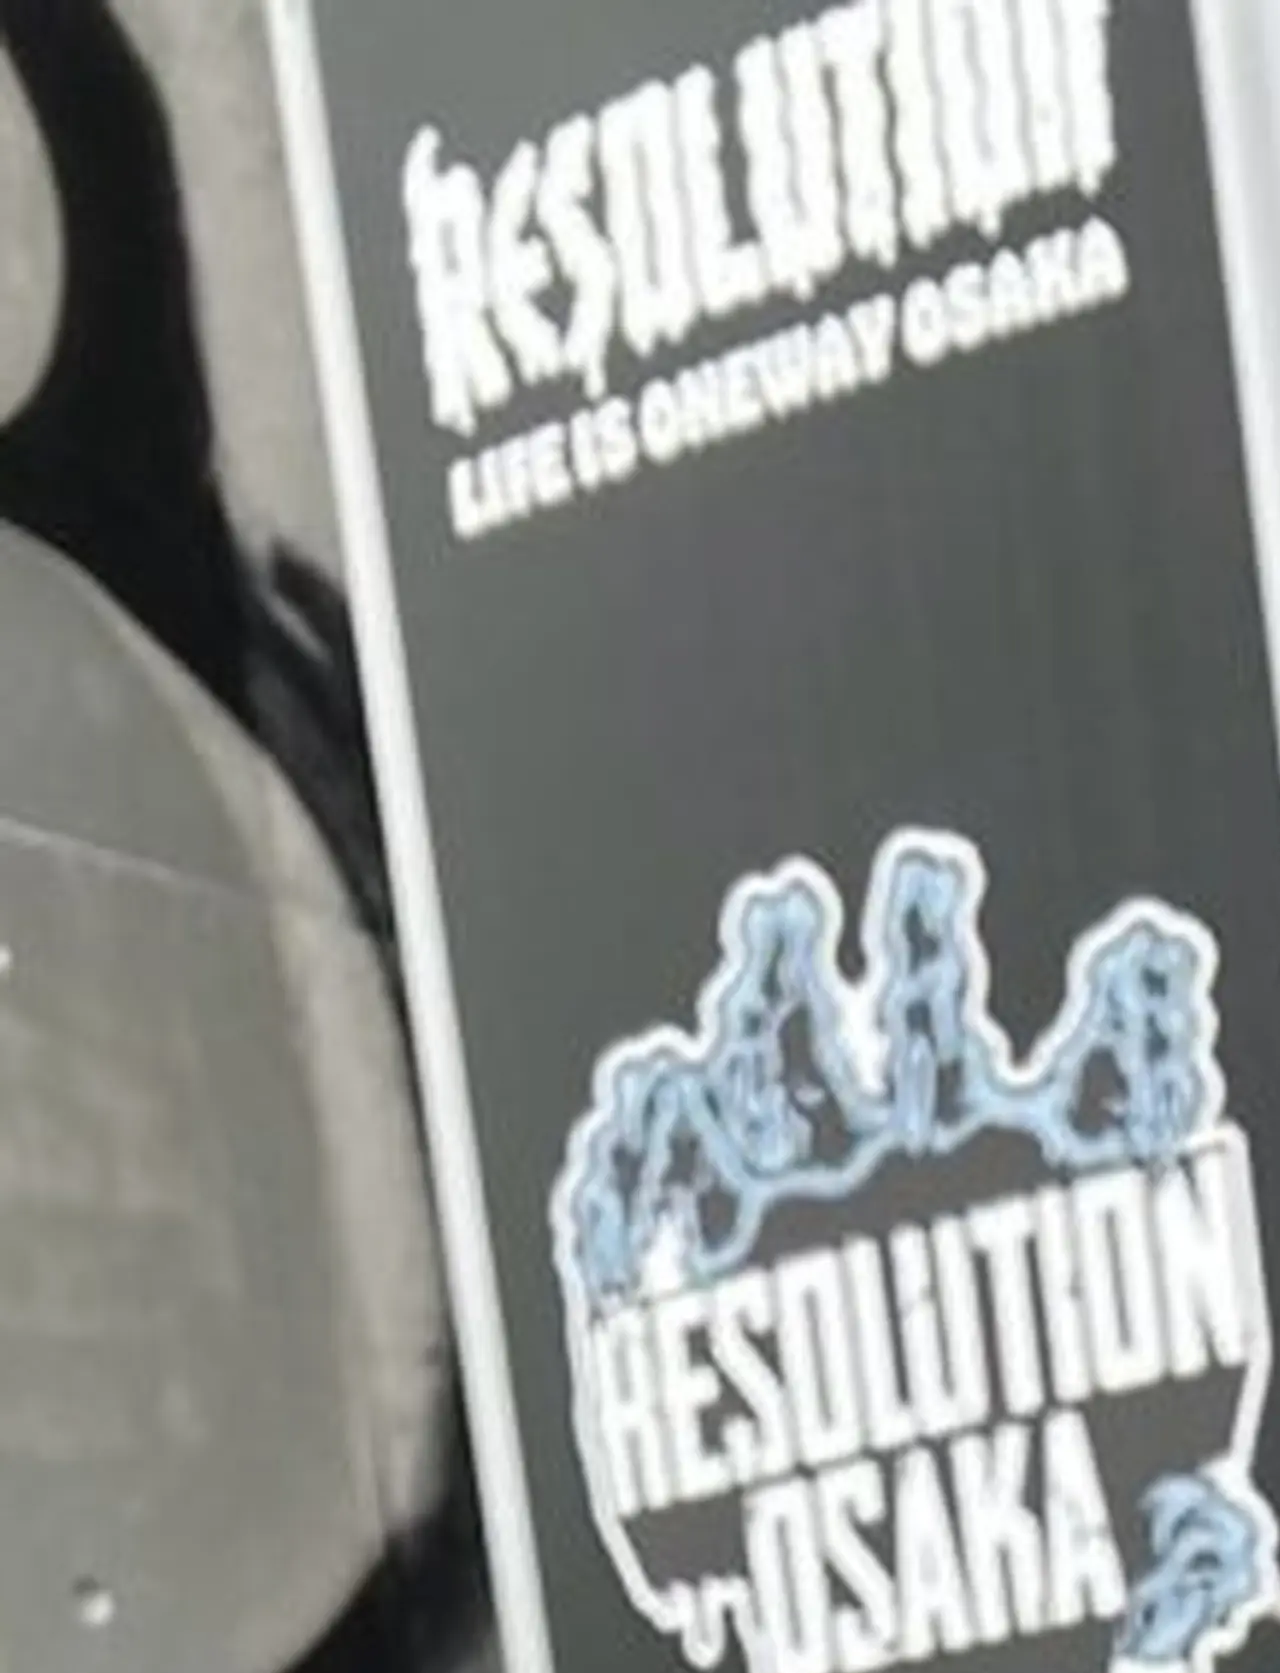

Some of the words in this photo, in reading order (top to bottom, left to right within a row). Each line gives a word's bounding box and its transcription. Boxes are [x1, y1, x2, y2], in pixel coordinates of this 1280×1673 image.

[404, 0, 1116, 436] RESOLUTION
[449, 424, 572, 540] LIFE
[572, 397, 636, 487] IS
[639, 293, 897, 462] ONEWAY
[901, 215, 1129, 366] OSAKA
[590, 1150, 1248, 1518] RESOLUTION
